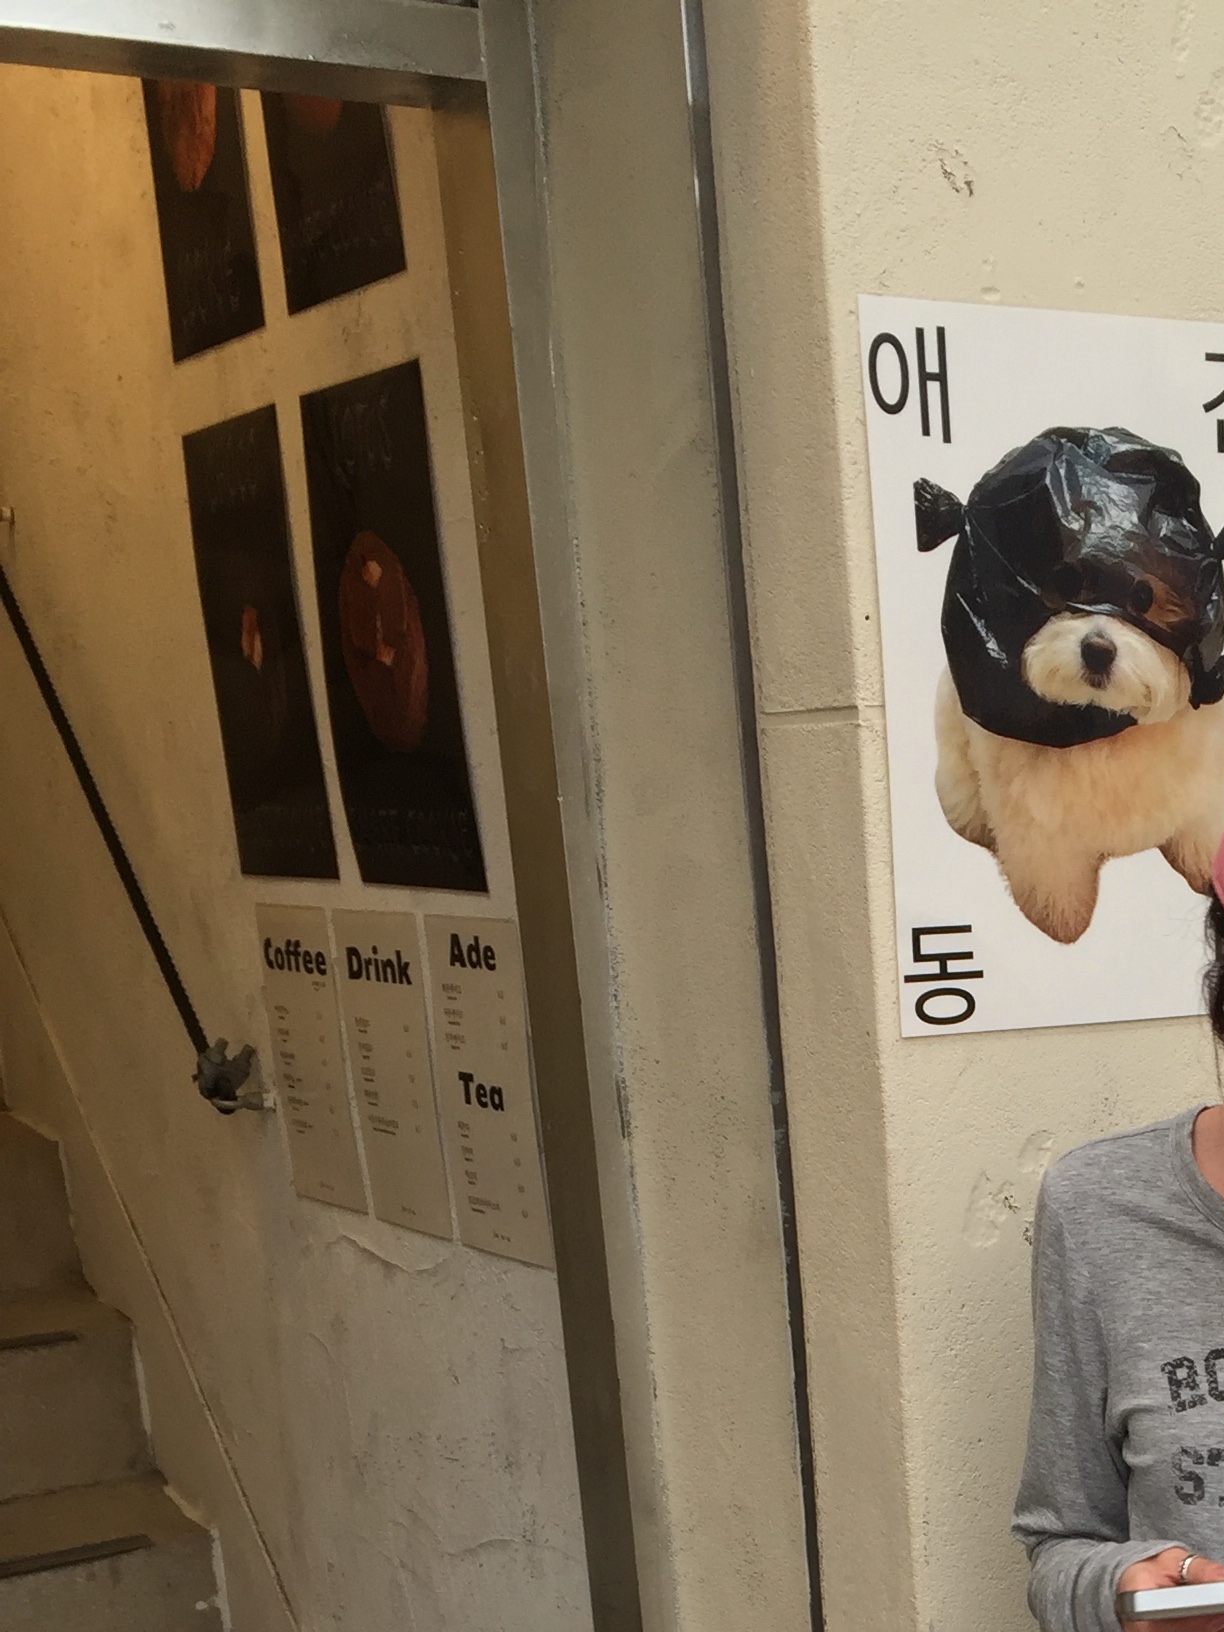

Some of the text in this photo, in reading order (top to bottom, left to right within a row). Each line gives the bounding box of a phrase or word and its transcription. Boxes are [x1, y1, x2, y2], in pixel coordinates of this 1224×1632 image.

[867, 326, 952, 444] 애
[264, 936, 328, 977] Coffee
[346, 945, 412, 986] Drink
[449, 933, 497, 972] Ade
[903, 924, 984, 1025] 동
[458, 1071, 505, 1113] Tea
